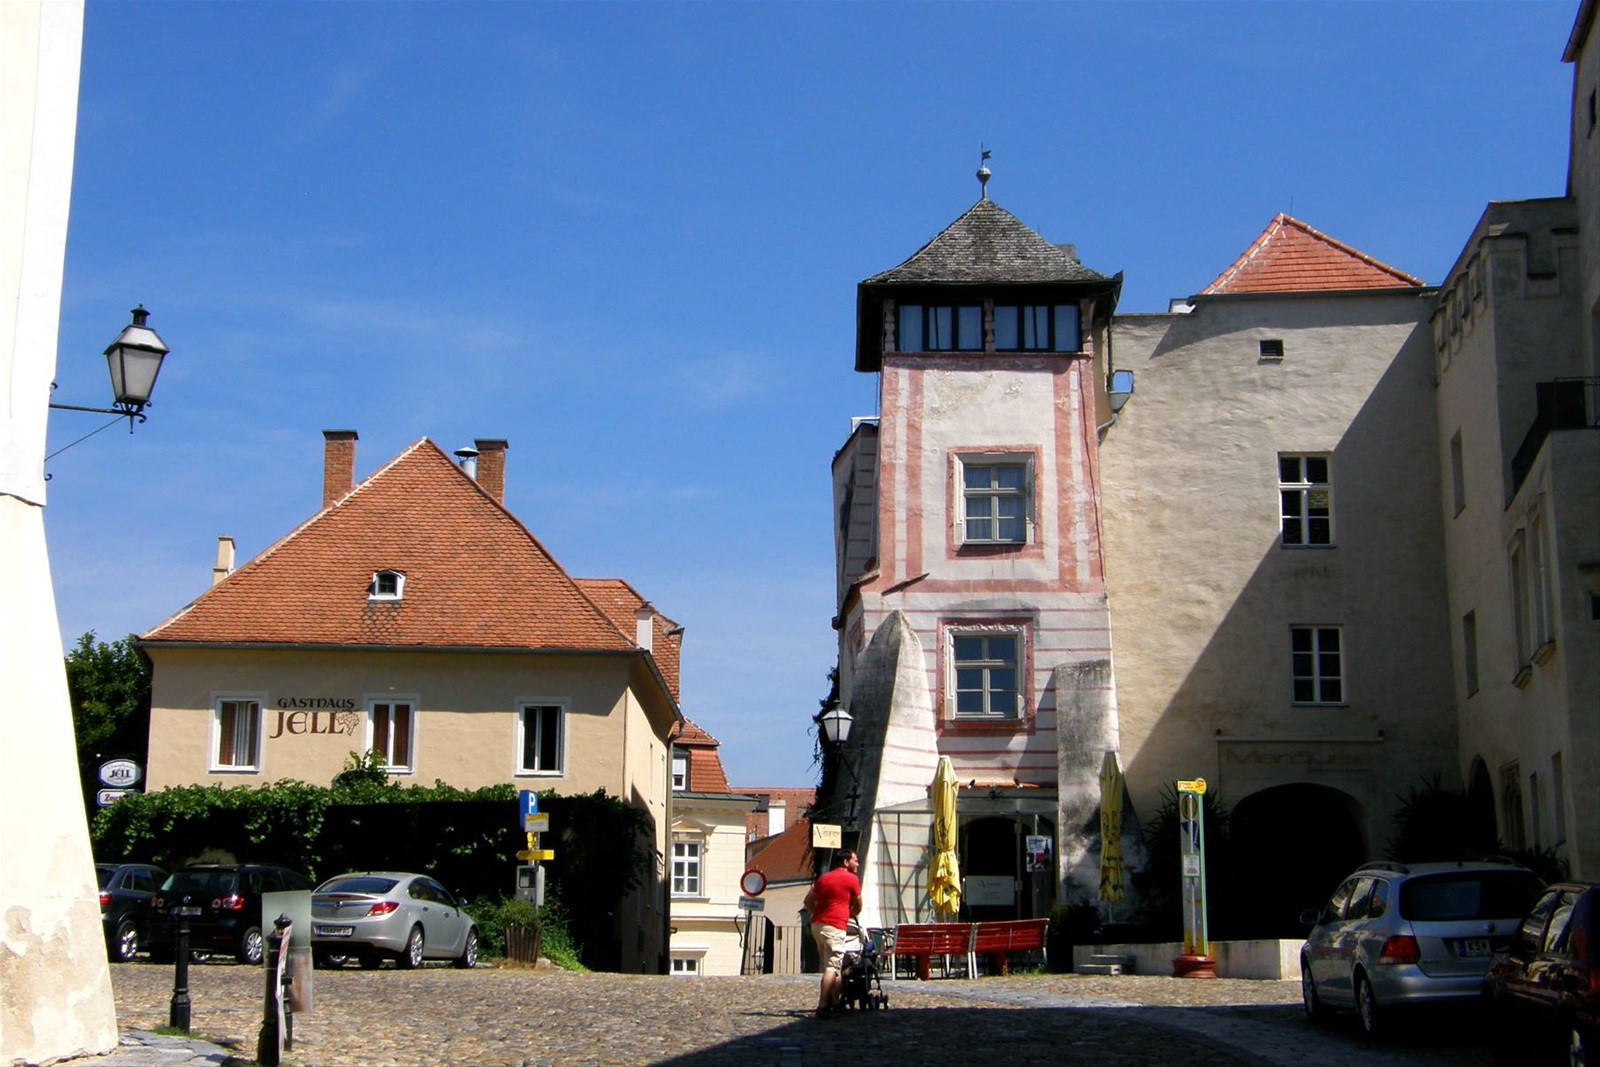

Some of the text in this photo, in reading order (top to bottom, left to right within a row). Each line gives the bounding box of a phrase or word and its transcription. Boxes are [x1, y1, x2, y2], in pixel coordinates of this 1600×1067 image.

[277, 698, 355, 709] GASTHAUS
[269, 711, 345, 739] JELL
[528, 792, 536, 814] P
